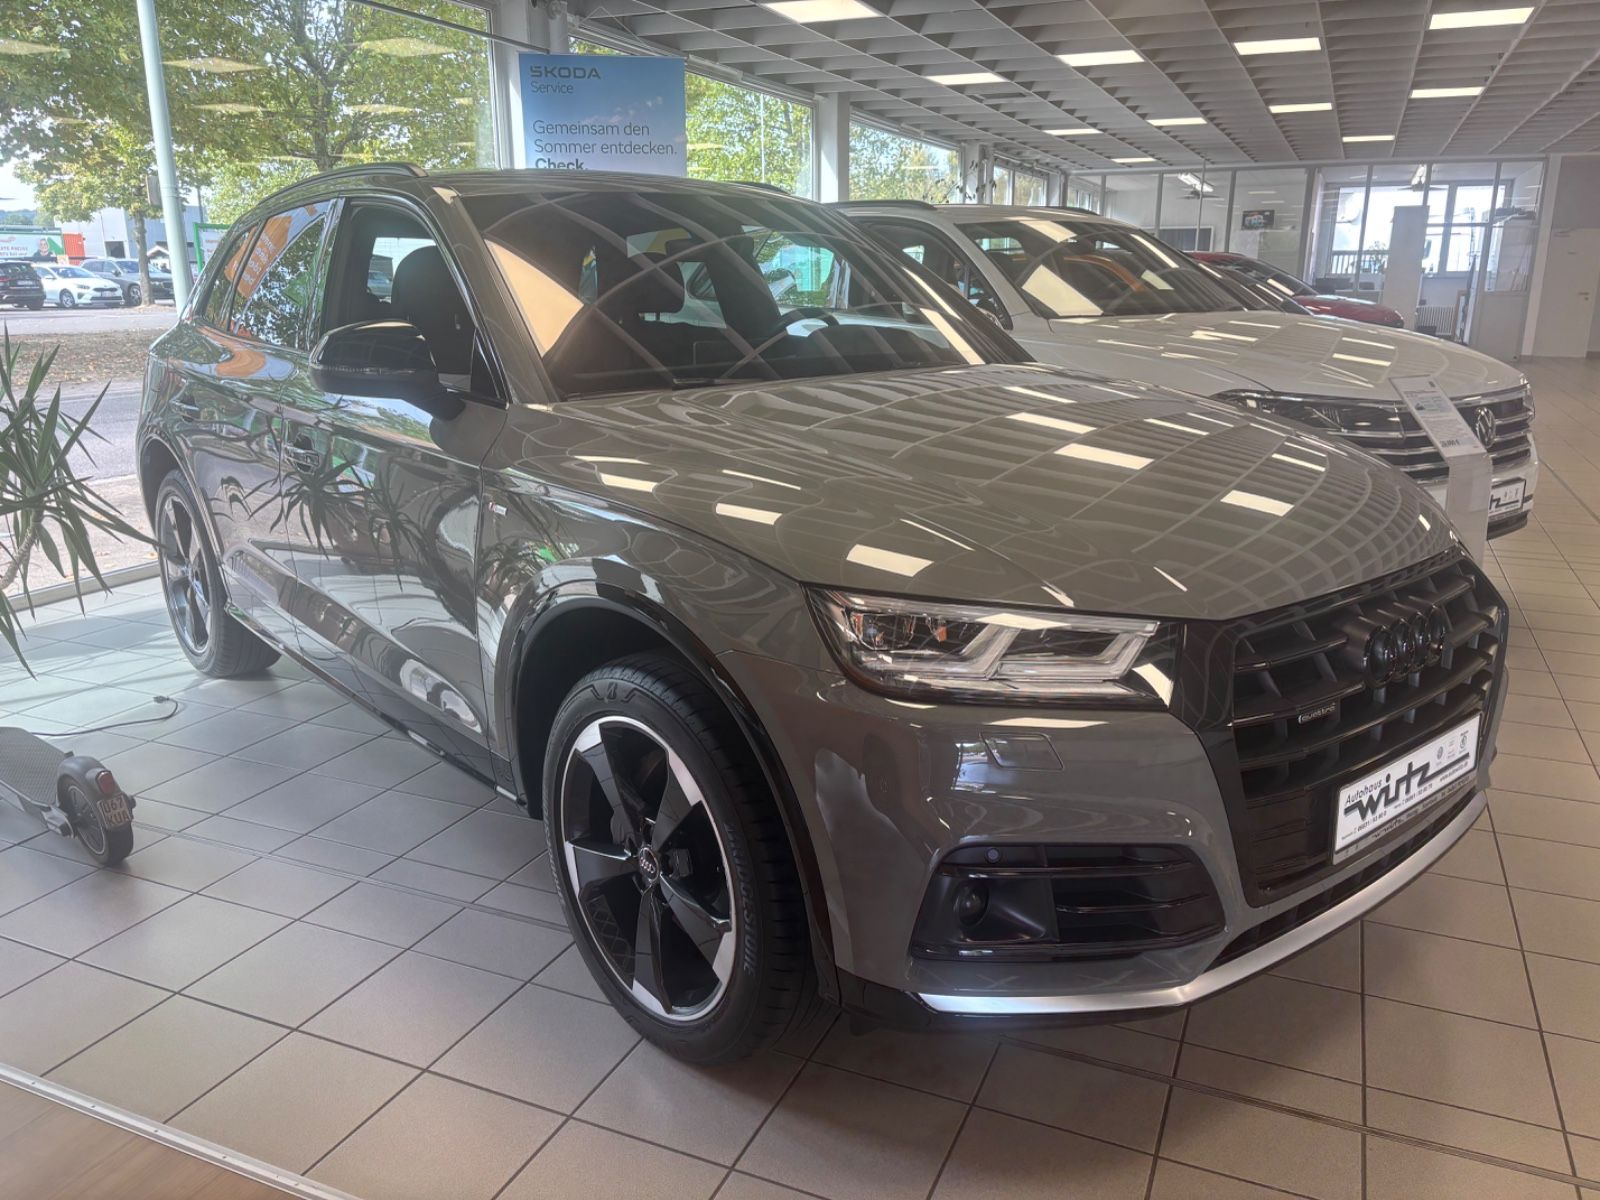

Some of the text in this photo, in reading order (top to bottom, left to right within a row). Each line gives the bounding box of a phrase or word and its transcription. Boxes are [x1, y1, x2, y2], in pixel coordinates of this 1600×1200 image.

[531, 80, 574, 94] Service
[533, 120, 649, 136] Gemeinsam den
[534, 139, 678, 155] Sommer entdecken.
[1345, 779, 1382, 806] Autohaus
